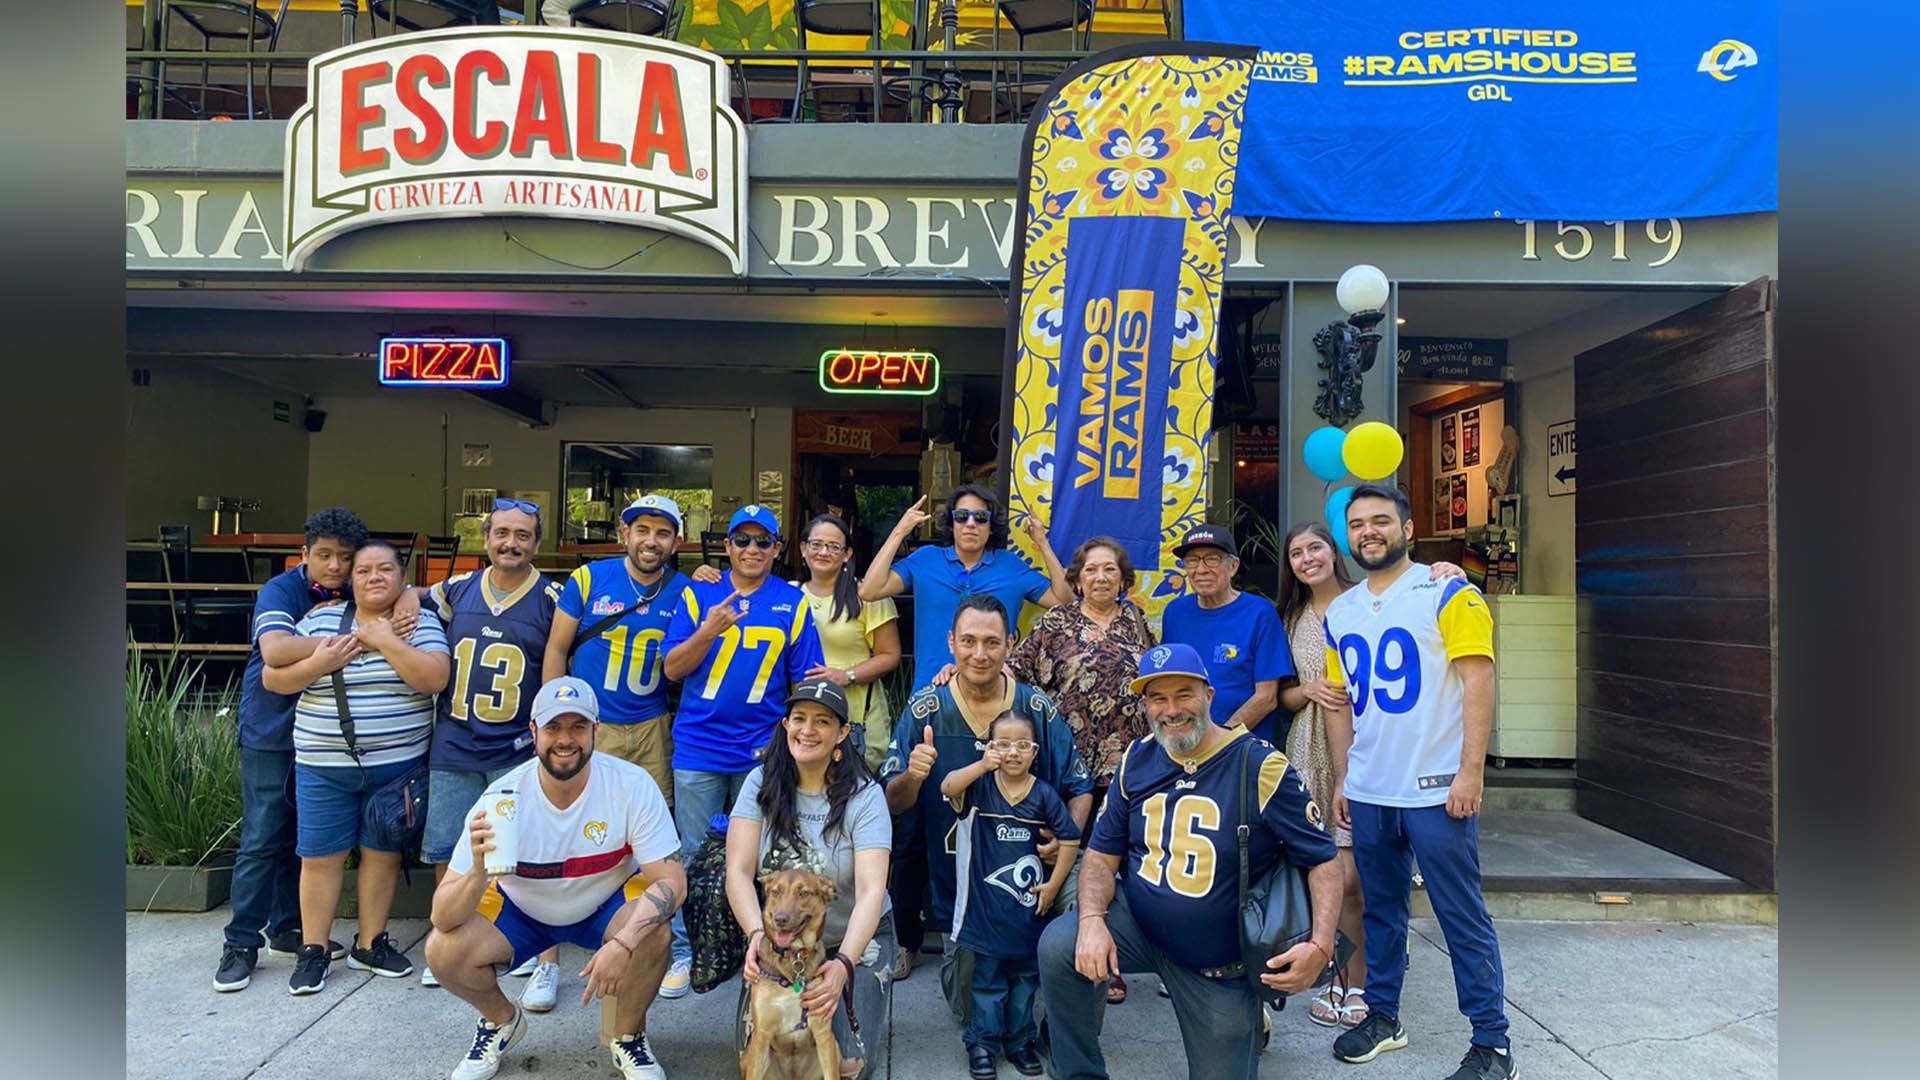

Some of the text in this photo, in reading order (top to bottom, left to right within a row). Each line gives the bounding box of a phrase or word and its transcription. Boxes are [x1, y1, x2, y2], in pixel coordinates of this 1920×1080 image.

[1399, 28, 1578, 49] CERTIFIED
[1253, 66, 1309, 81] AMS
[1257, 51, 1313, 66] MOS
[1344, 50, 1637, 75] #RAMSHOUSE
[1468, 84, 1512, 101] GDL
[339, 50, 693, 178] ESCALA
[374, 181, 647, 213] CERVEZA ARTESANAL
[1515, 218, 1683, 267] 1519
[386, 343, 499, 379] PIZZA
[830, 353, 928, 384] OPEN
[1074, 297, 1113, 489] VAMOS
[1109, 310, 1148, 478] RAMS
[824, 425, 872, 450] BEER
[601, 625, 666, 696] 10
[701, 624, 786, 704] 77
[1339, 627, 1421, 717] 99
[450, 637, 526, 723] 13
[996, 824, 1031, 841] Rams
[1137, 793, 1221, 898] 16
